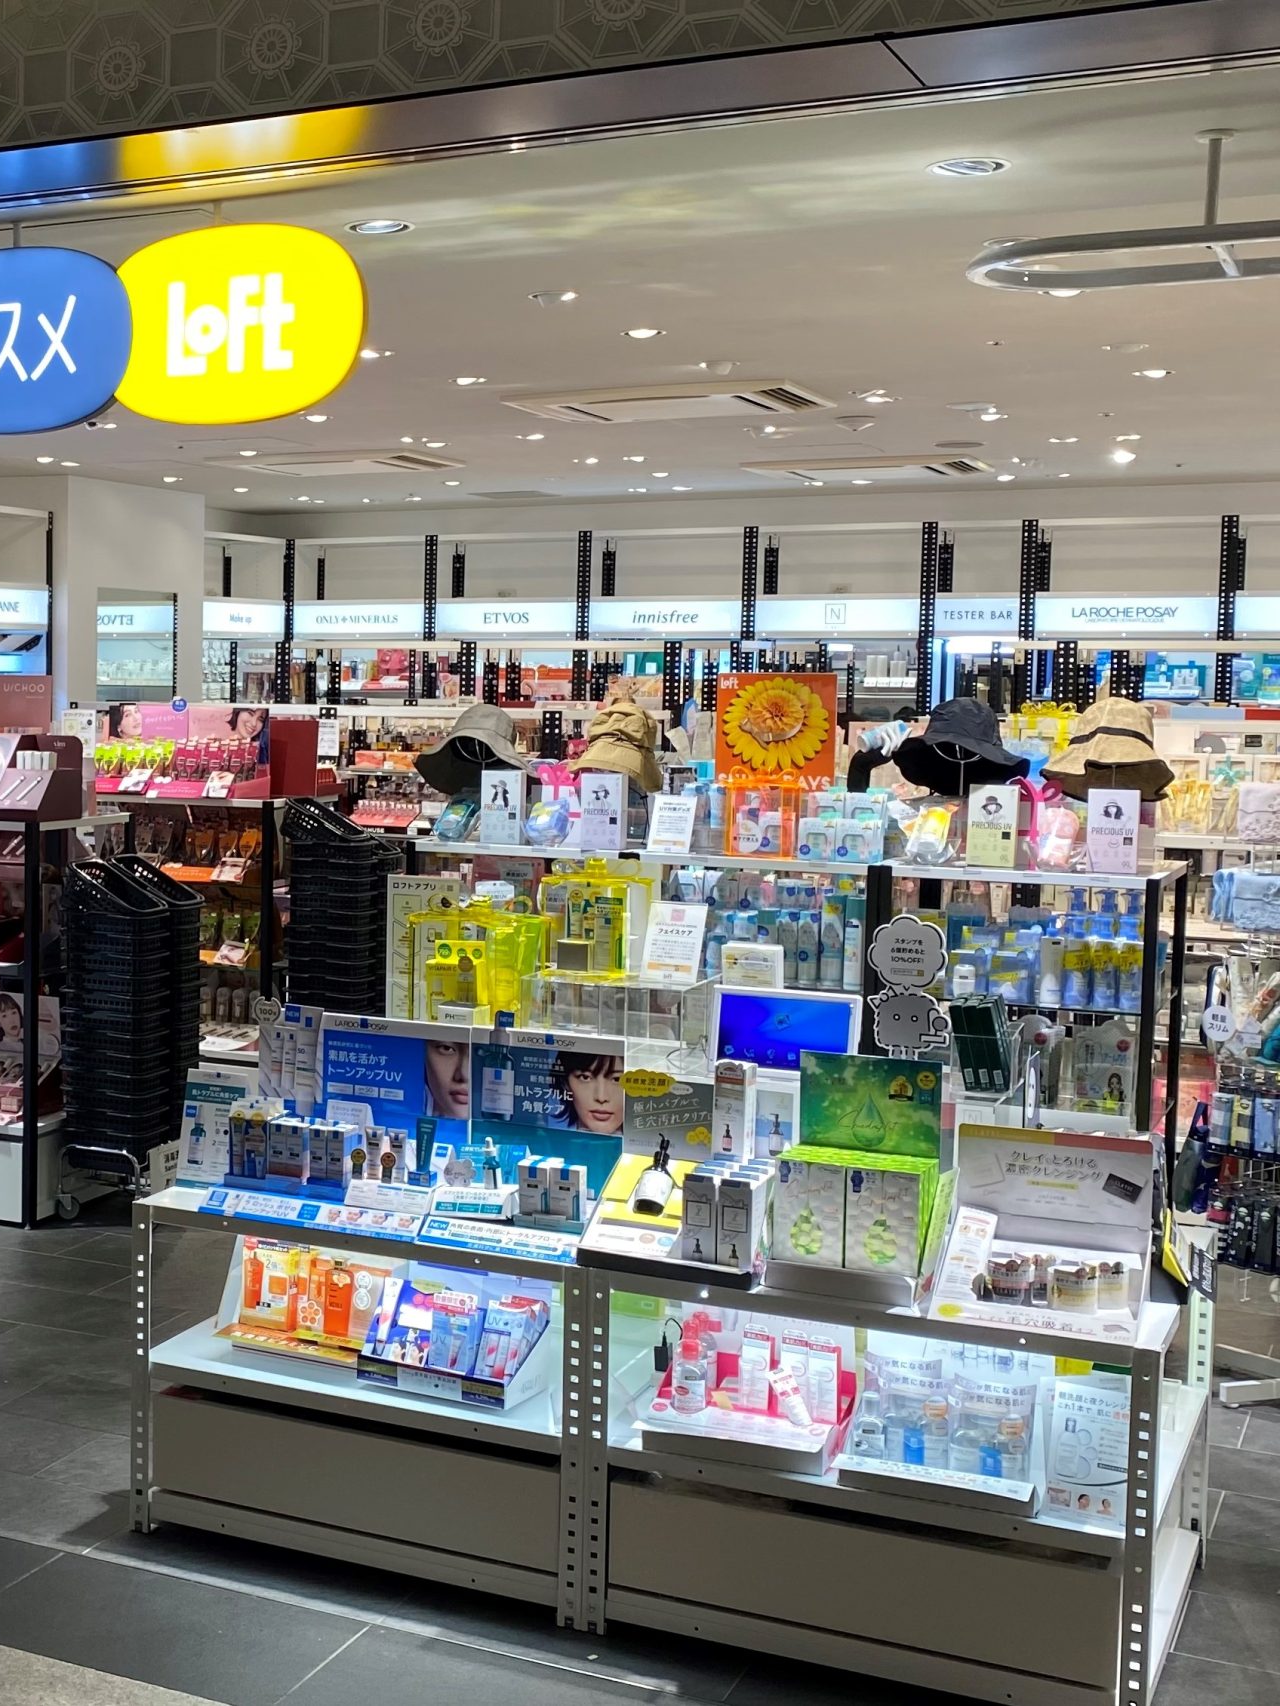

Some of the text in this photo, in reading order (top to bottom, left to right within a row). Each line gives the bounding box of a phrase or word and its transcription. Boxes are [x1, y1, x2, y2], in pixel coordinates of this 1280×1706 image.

[483, 611, 530, 624] ETVOS
[632, 610, 699, 625] innisfree
[943, 610, 1014, 621] TESTER BAR
[1071, 606, 1179, 618] LA ROCHE POSAY
[315, 613, 399, 625] ONLY MINERALS
[483, 803, 509, 812] PRECIOUS
[583, 807, 609, 816] PRECIOUS
[971, 821, 1013, 831] PRECIOUS UV
[1091, 827, 1135, 837] PRECIOUS UV
[392, 881, 437, 891] ロフトアプリ
[1207, 1023, 1229, 1034] スリム
[328, 1049, 389, 1066] 素肌を活かす
[327, 1063, 403, 1082] トーンアップUV
[514, 1084, 574, 1102] 肌トラブルに
[522, 1100, 566, 1115] 角質ケア
[632, 1097, 700, 1114] 極小バブルで
[429, 1220, 448, 1230] NEW
